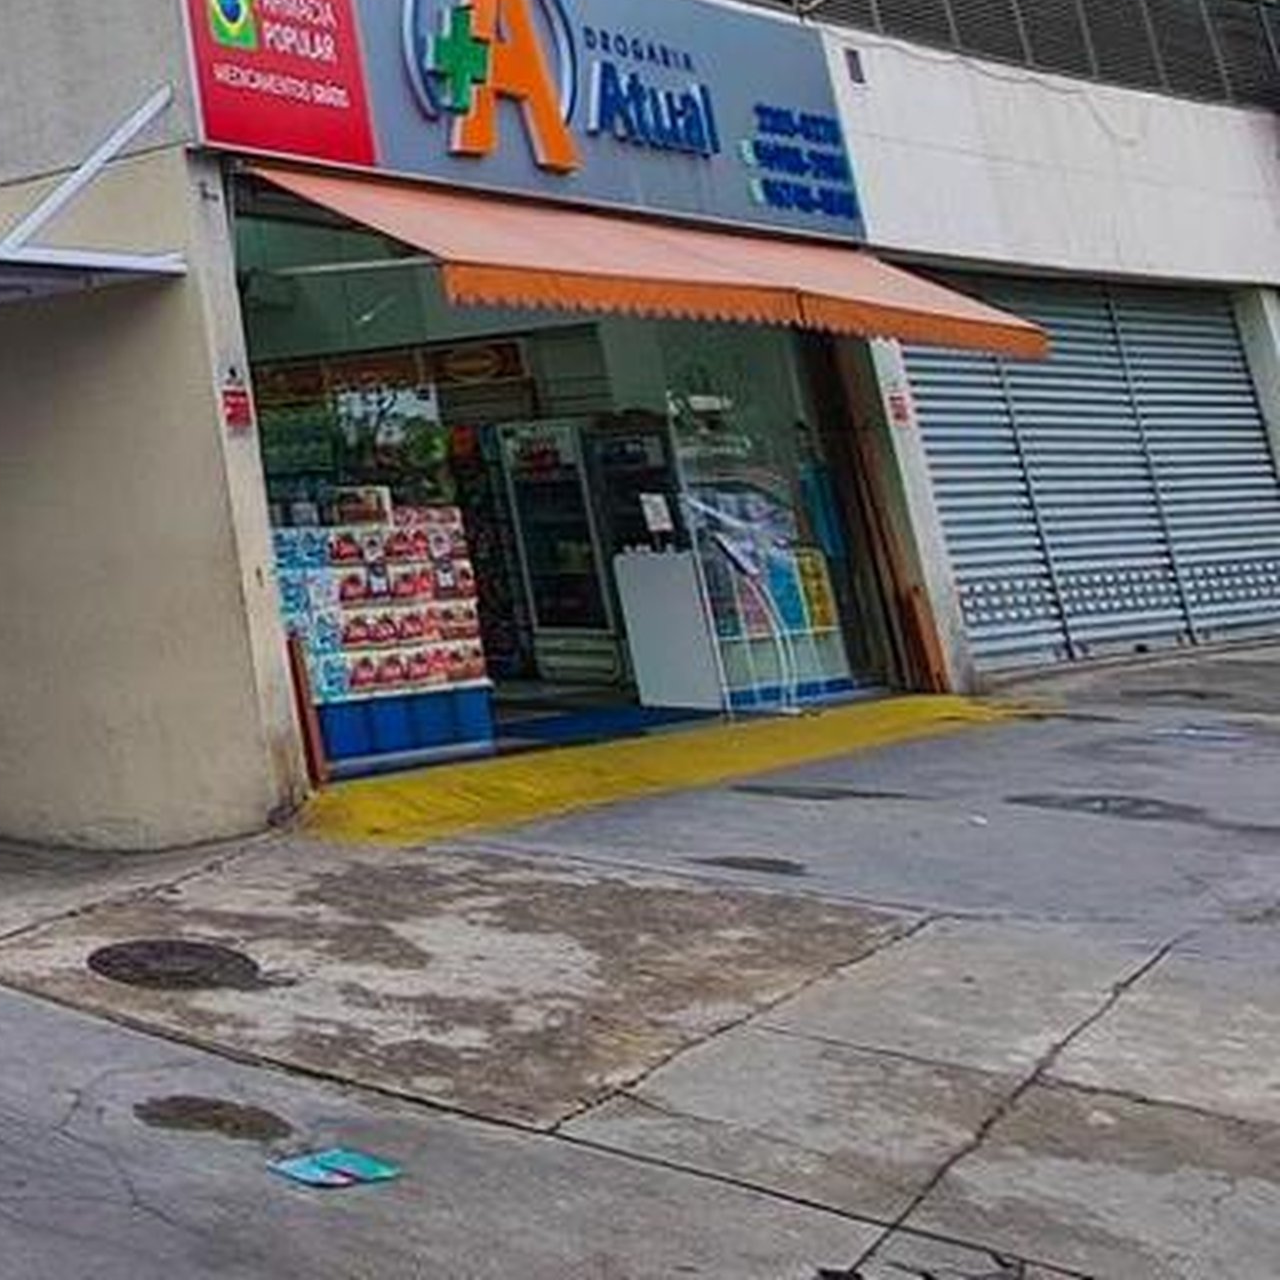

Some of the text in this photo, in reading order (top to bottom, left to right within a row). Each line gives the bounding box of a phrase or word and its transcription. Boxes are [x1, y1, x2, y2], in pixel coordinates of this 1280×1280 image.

[262, 22, 339, 64] POPULAR
[583, 26, 697, 72] DROGARIA
[587, 58, 722, 160] Atual
